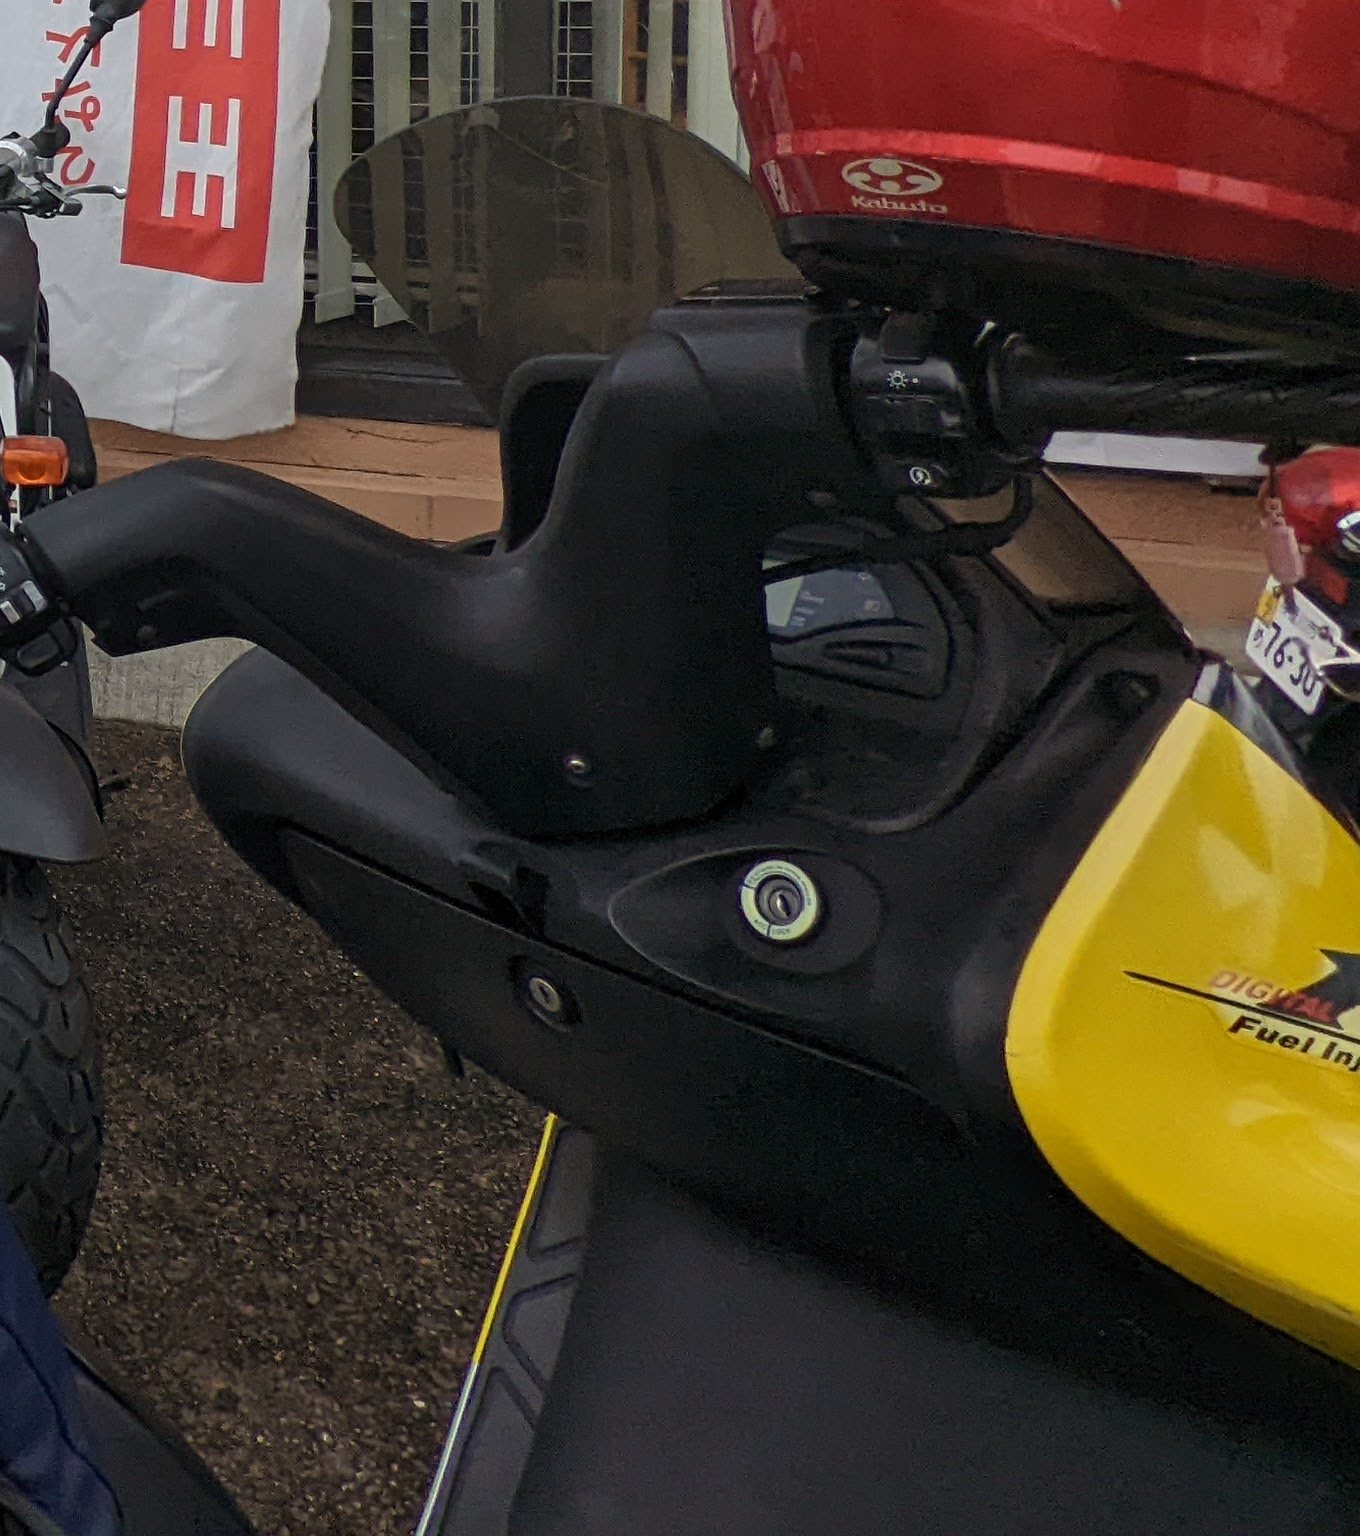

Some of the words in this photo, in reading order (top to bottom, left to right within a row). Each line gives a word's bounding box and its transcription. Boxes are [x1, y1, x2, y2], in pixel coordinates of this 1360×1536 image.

[161, 94, 240, 229] 王
[851, 193, 948, 215] Kabuto
[1228, 1015, 1317, 1054] Fuel
